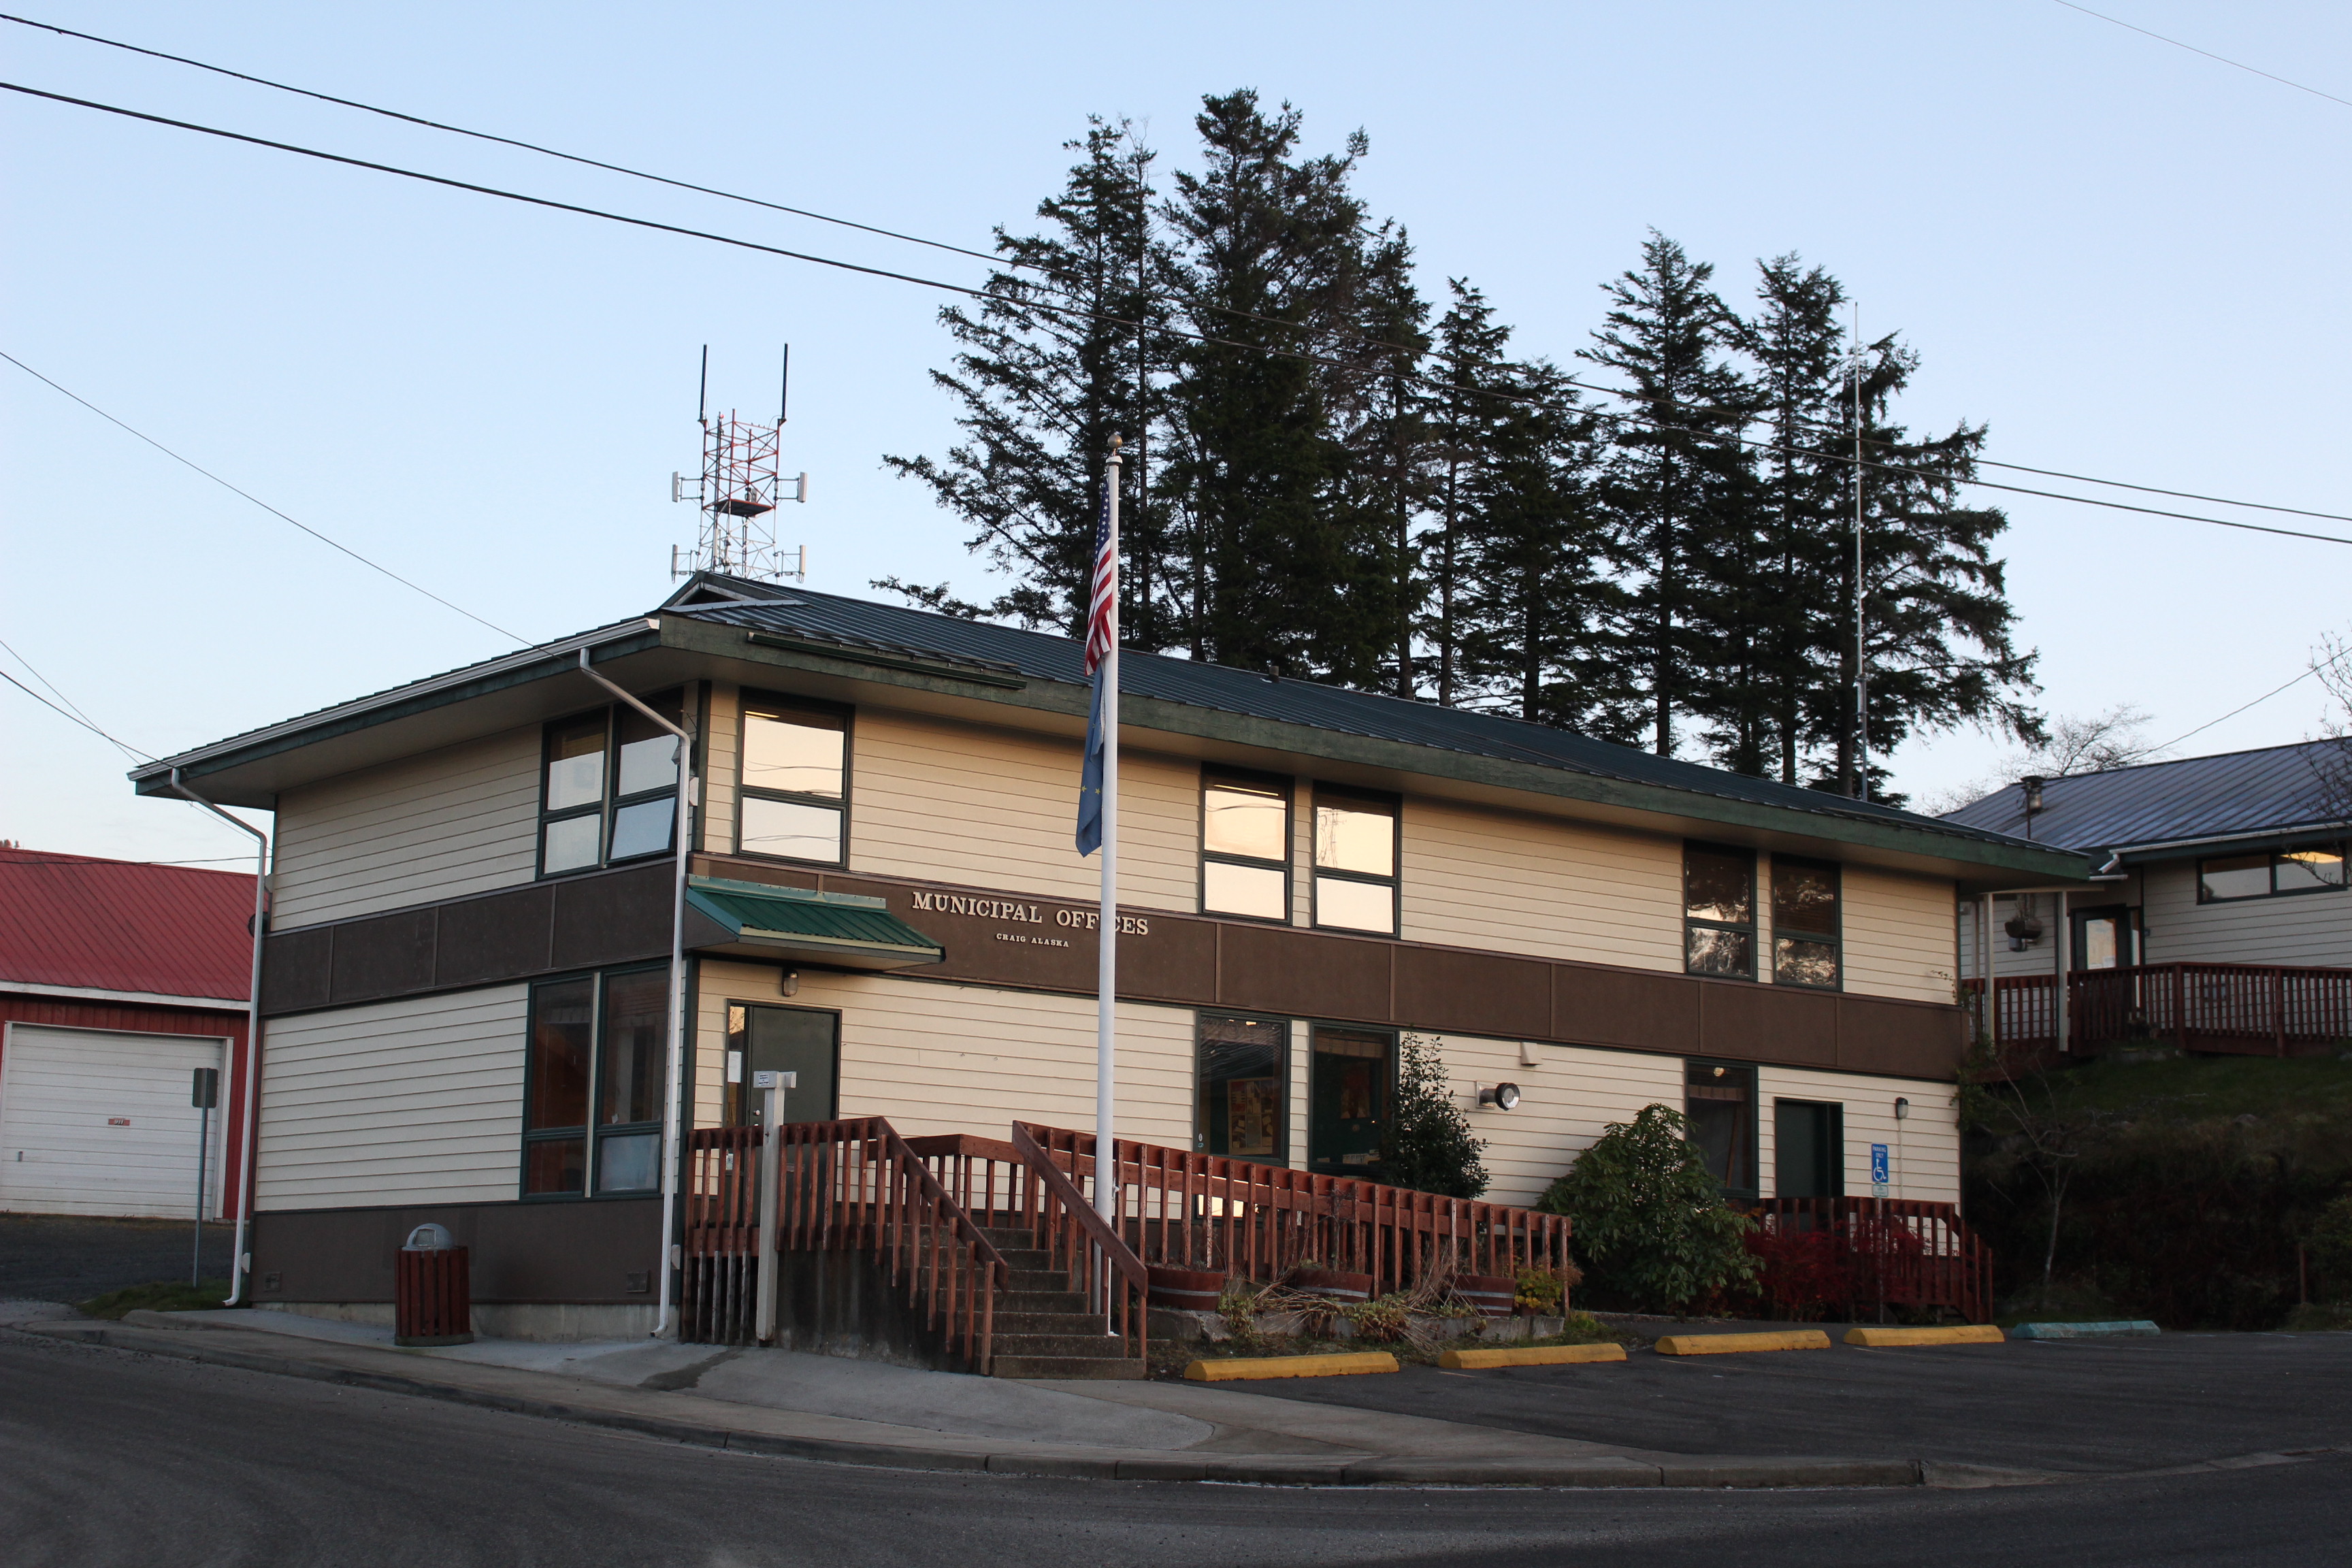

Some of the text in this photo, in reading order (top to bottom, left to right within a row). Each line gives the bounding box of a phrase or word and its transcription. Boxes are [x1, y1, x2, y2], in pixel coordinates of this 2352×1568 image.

[912, 891, 1149, 936] MUNICIPAL OFFES
[996, 932, 1069, 948] CRAIG ALASKA
[1872, 1145, 1886, 1154] PARKING
